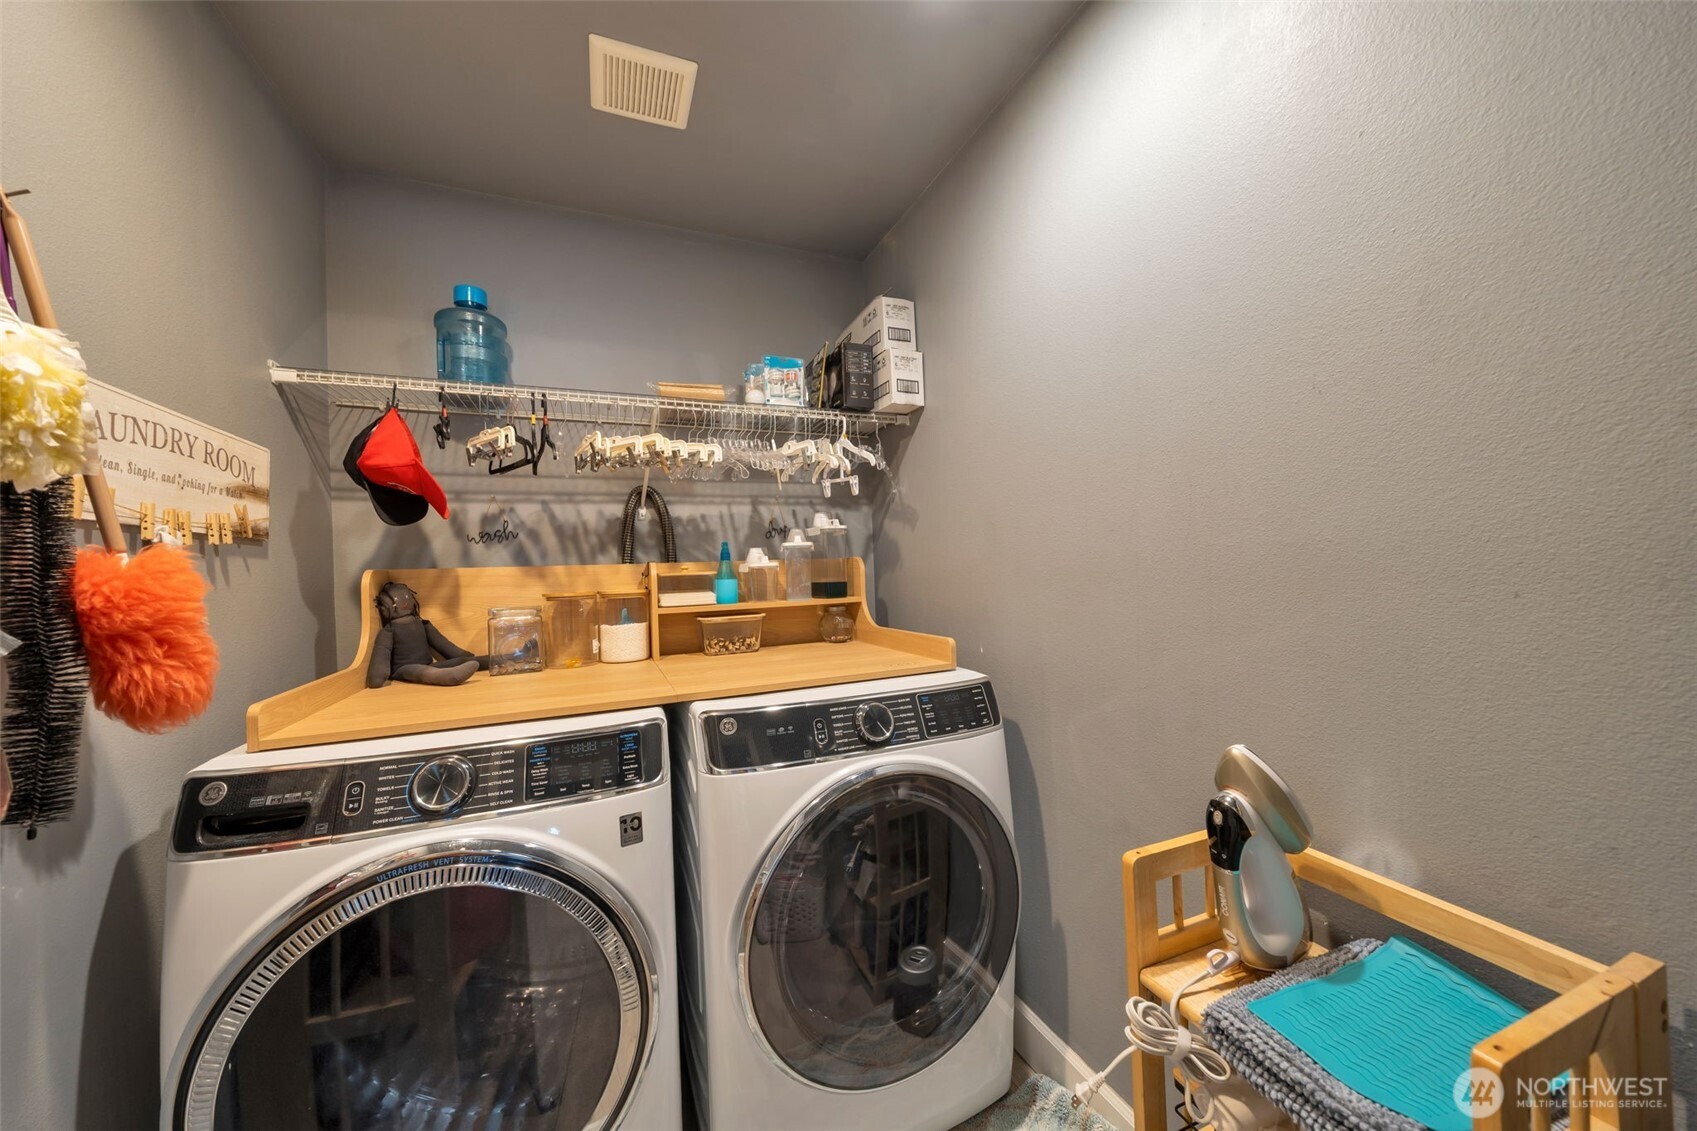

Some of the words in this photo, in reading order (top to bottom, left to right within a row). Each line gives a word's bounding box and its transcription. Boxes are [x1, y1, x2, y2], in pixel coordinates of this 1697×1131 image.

[94, 409, 199, 459] AUNDRY
[203, 440, 256, 487] ROOM
[161, 473, 177, 484] and
[467, 519, 519, 544] wash
[376, 861, 429, 882] ULTRAFRESH
[433, 857, 454, 867] VENT
